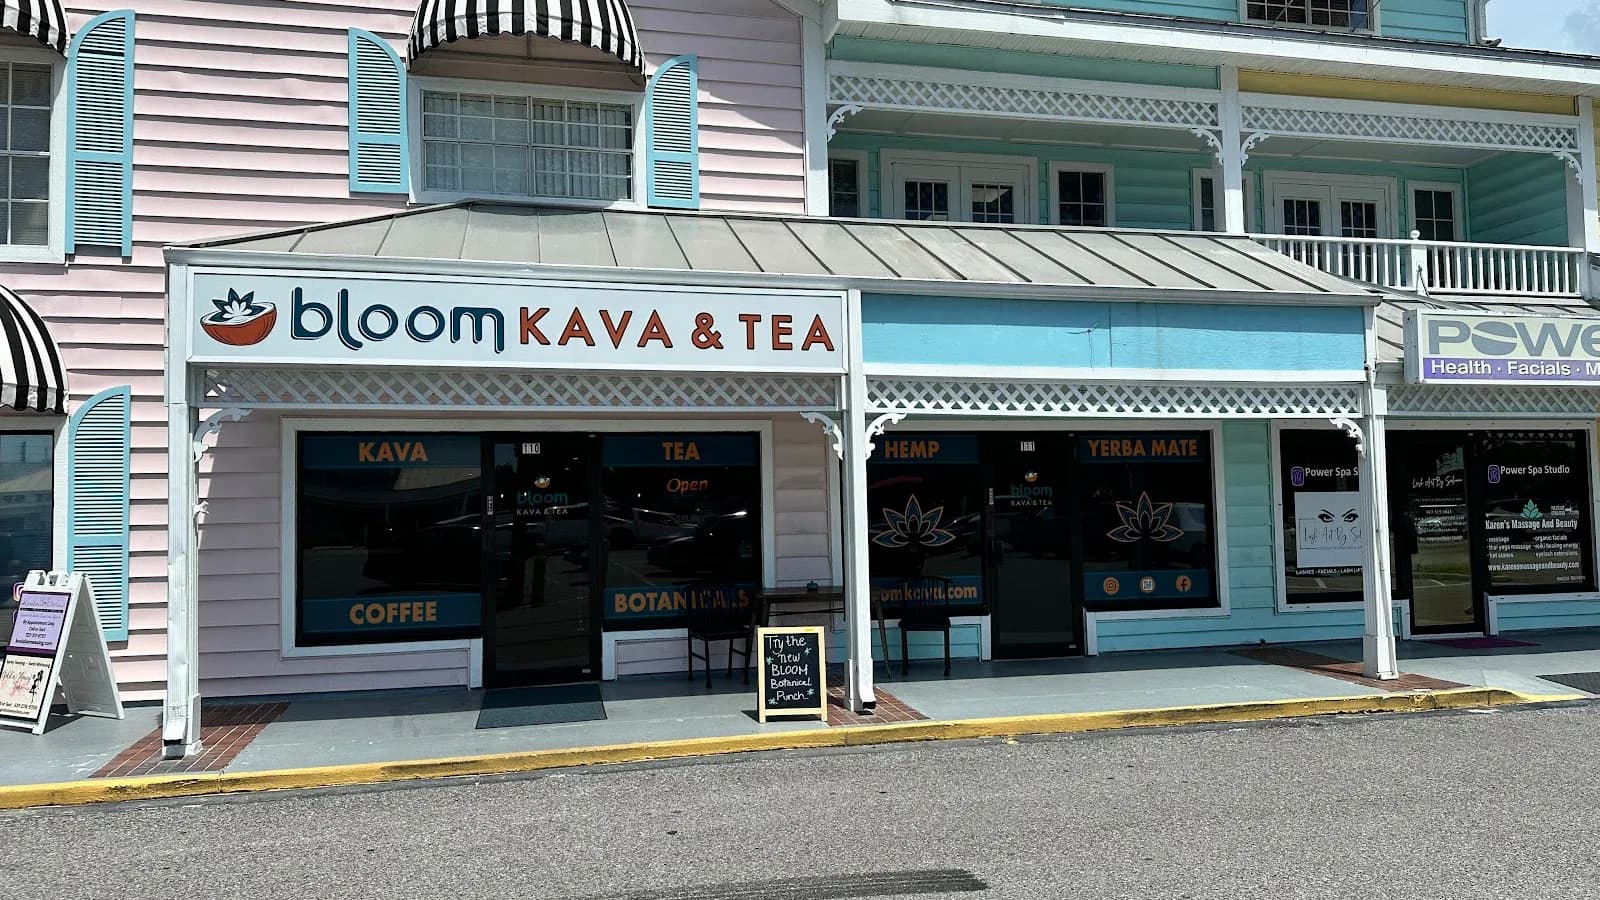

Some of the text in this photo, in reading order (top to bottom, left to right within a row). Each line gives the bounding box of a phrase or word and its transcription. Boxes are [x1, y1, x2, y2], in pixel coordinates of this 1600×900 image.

[291, 286, 835, 354] bloom KAVA & TEA
[1431, 359, 1492, 375] Health
[1507, 360, 1572, 376] Facials
[358, 441, 429, 463] KAVA
[521, 442, 541, 455] 110
[661, 441, 701, 461] TEA
[884, 440, 941, 459] HEMP
[1087, 438, 1198, 457] YERBA MATE
[1304, 467, 1333, 478] Power
[1335, 467, 1351, 478] Spa
[1500, 464, 1570, 477] Power Spa Studio
[665, 477, 709, 495] Open
[1009, 482, 1054, 498] bloom
[515, 490, 569, 506] bloom
[1010, 499, 1031, 507] KAVA
[1039, 499, 1054, 507] TEA
[516, 508, 542, 517] KAVA
[1485, 518, 1578, 531] Karen's Massage And Beauty
[614, 589, 751, 614] BOTANICAS
[349, 600, 438, 625] COFFEE
[764, 635, 807, 655] Try the
[777, 652, 801, 664] new
[771, 663, 809, 677] BLOOM
[770, 677, 813, 690] Botanical
